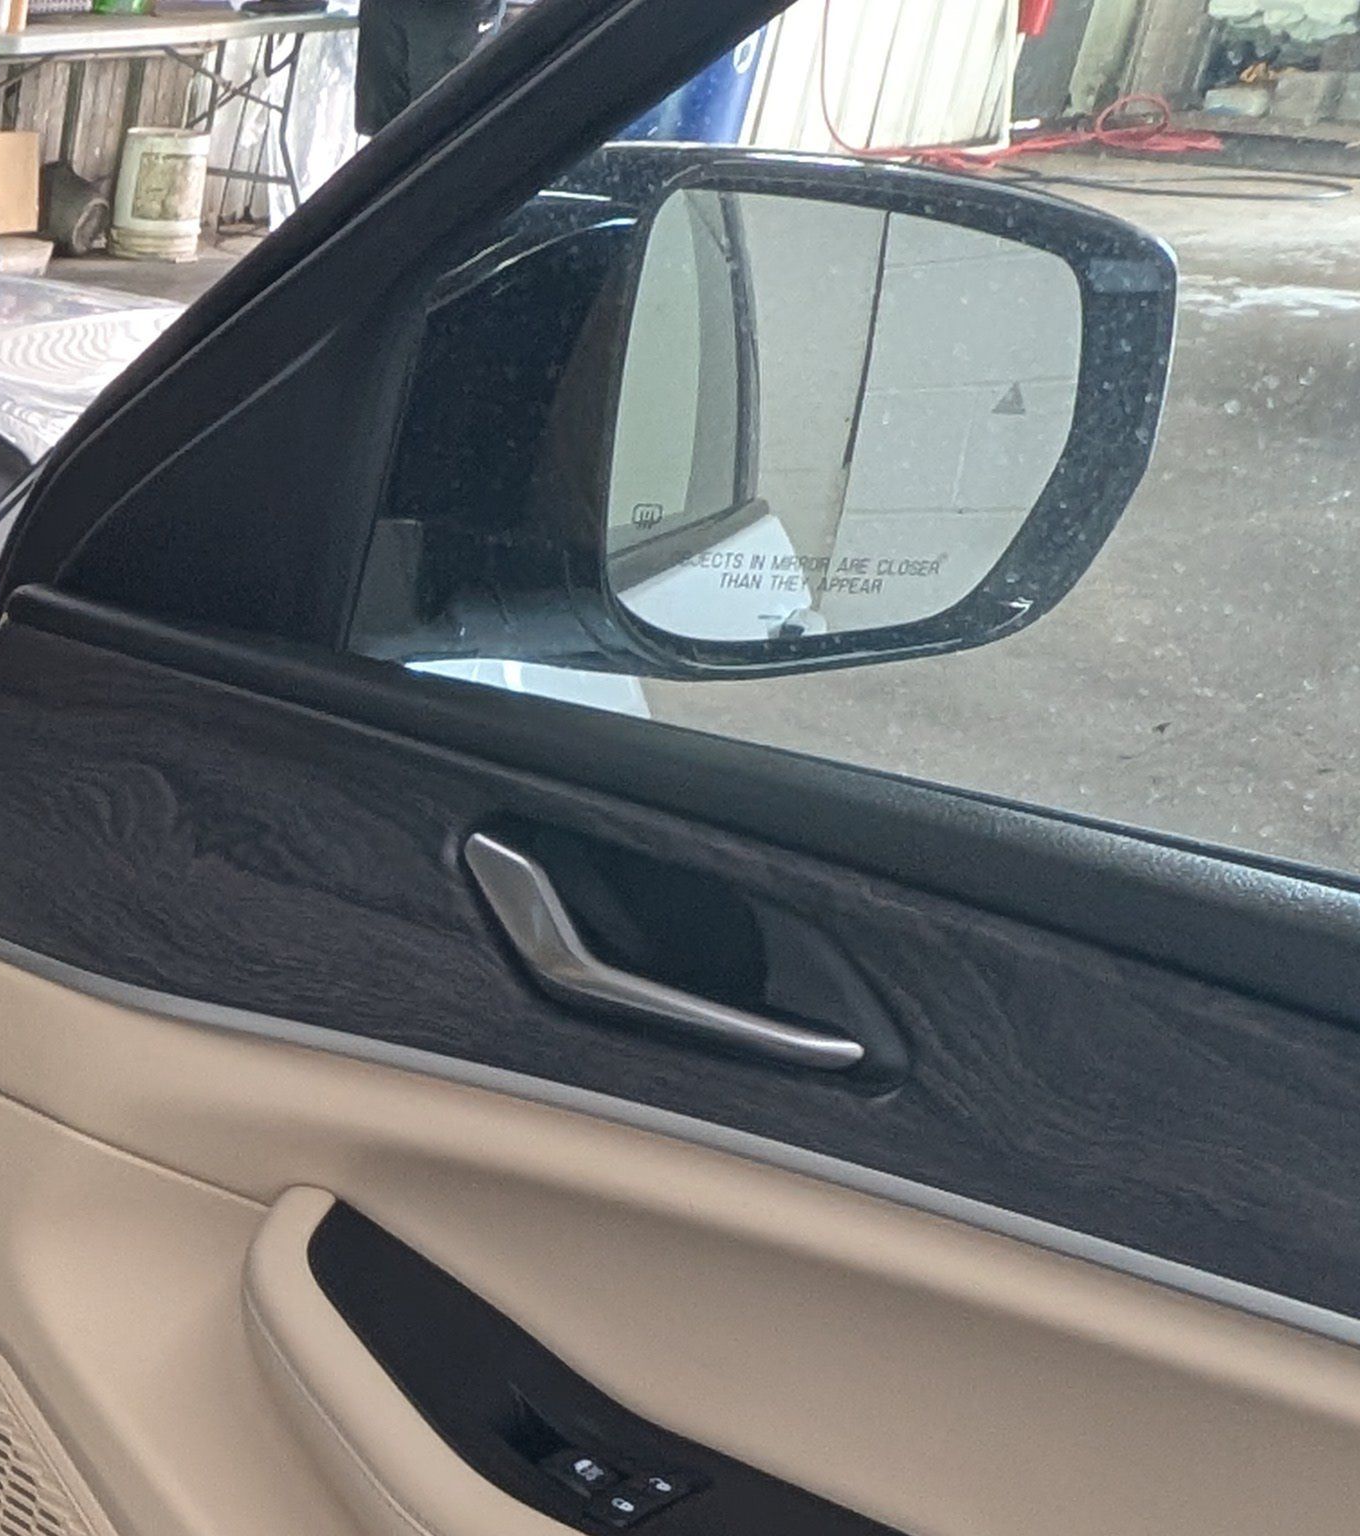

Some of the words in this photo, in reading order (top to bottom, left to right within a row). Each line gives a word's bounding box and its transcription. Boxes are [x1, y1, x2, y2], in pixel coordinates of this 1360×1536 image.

[749, 554, 766, 570] IN
[771, 555, 831, 575] MIRROR
[836, 557, 871, 575] ARE
[877, 559, 940, 577] CLOSER
[720, 572, 762, 589] THAN
[771, 574, 810, 592] THEY
[817, 576, 883, 594] APPEAR
